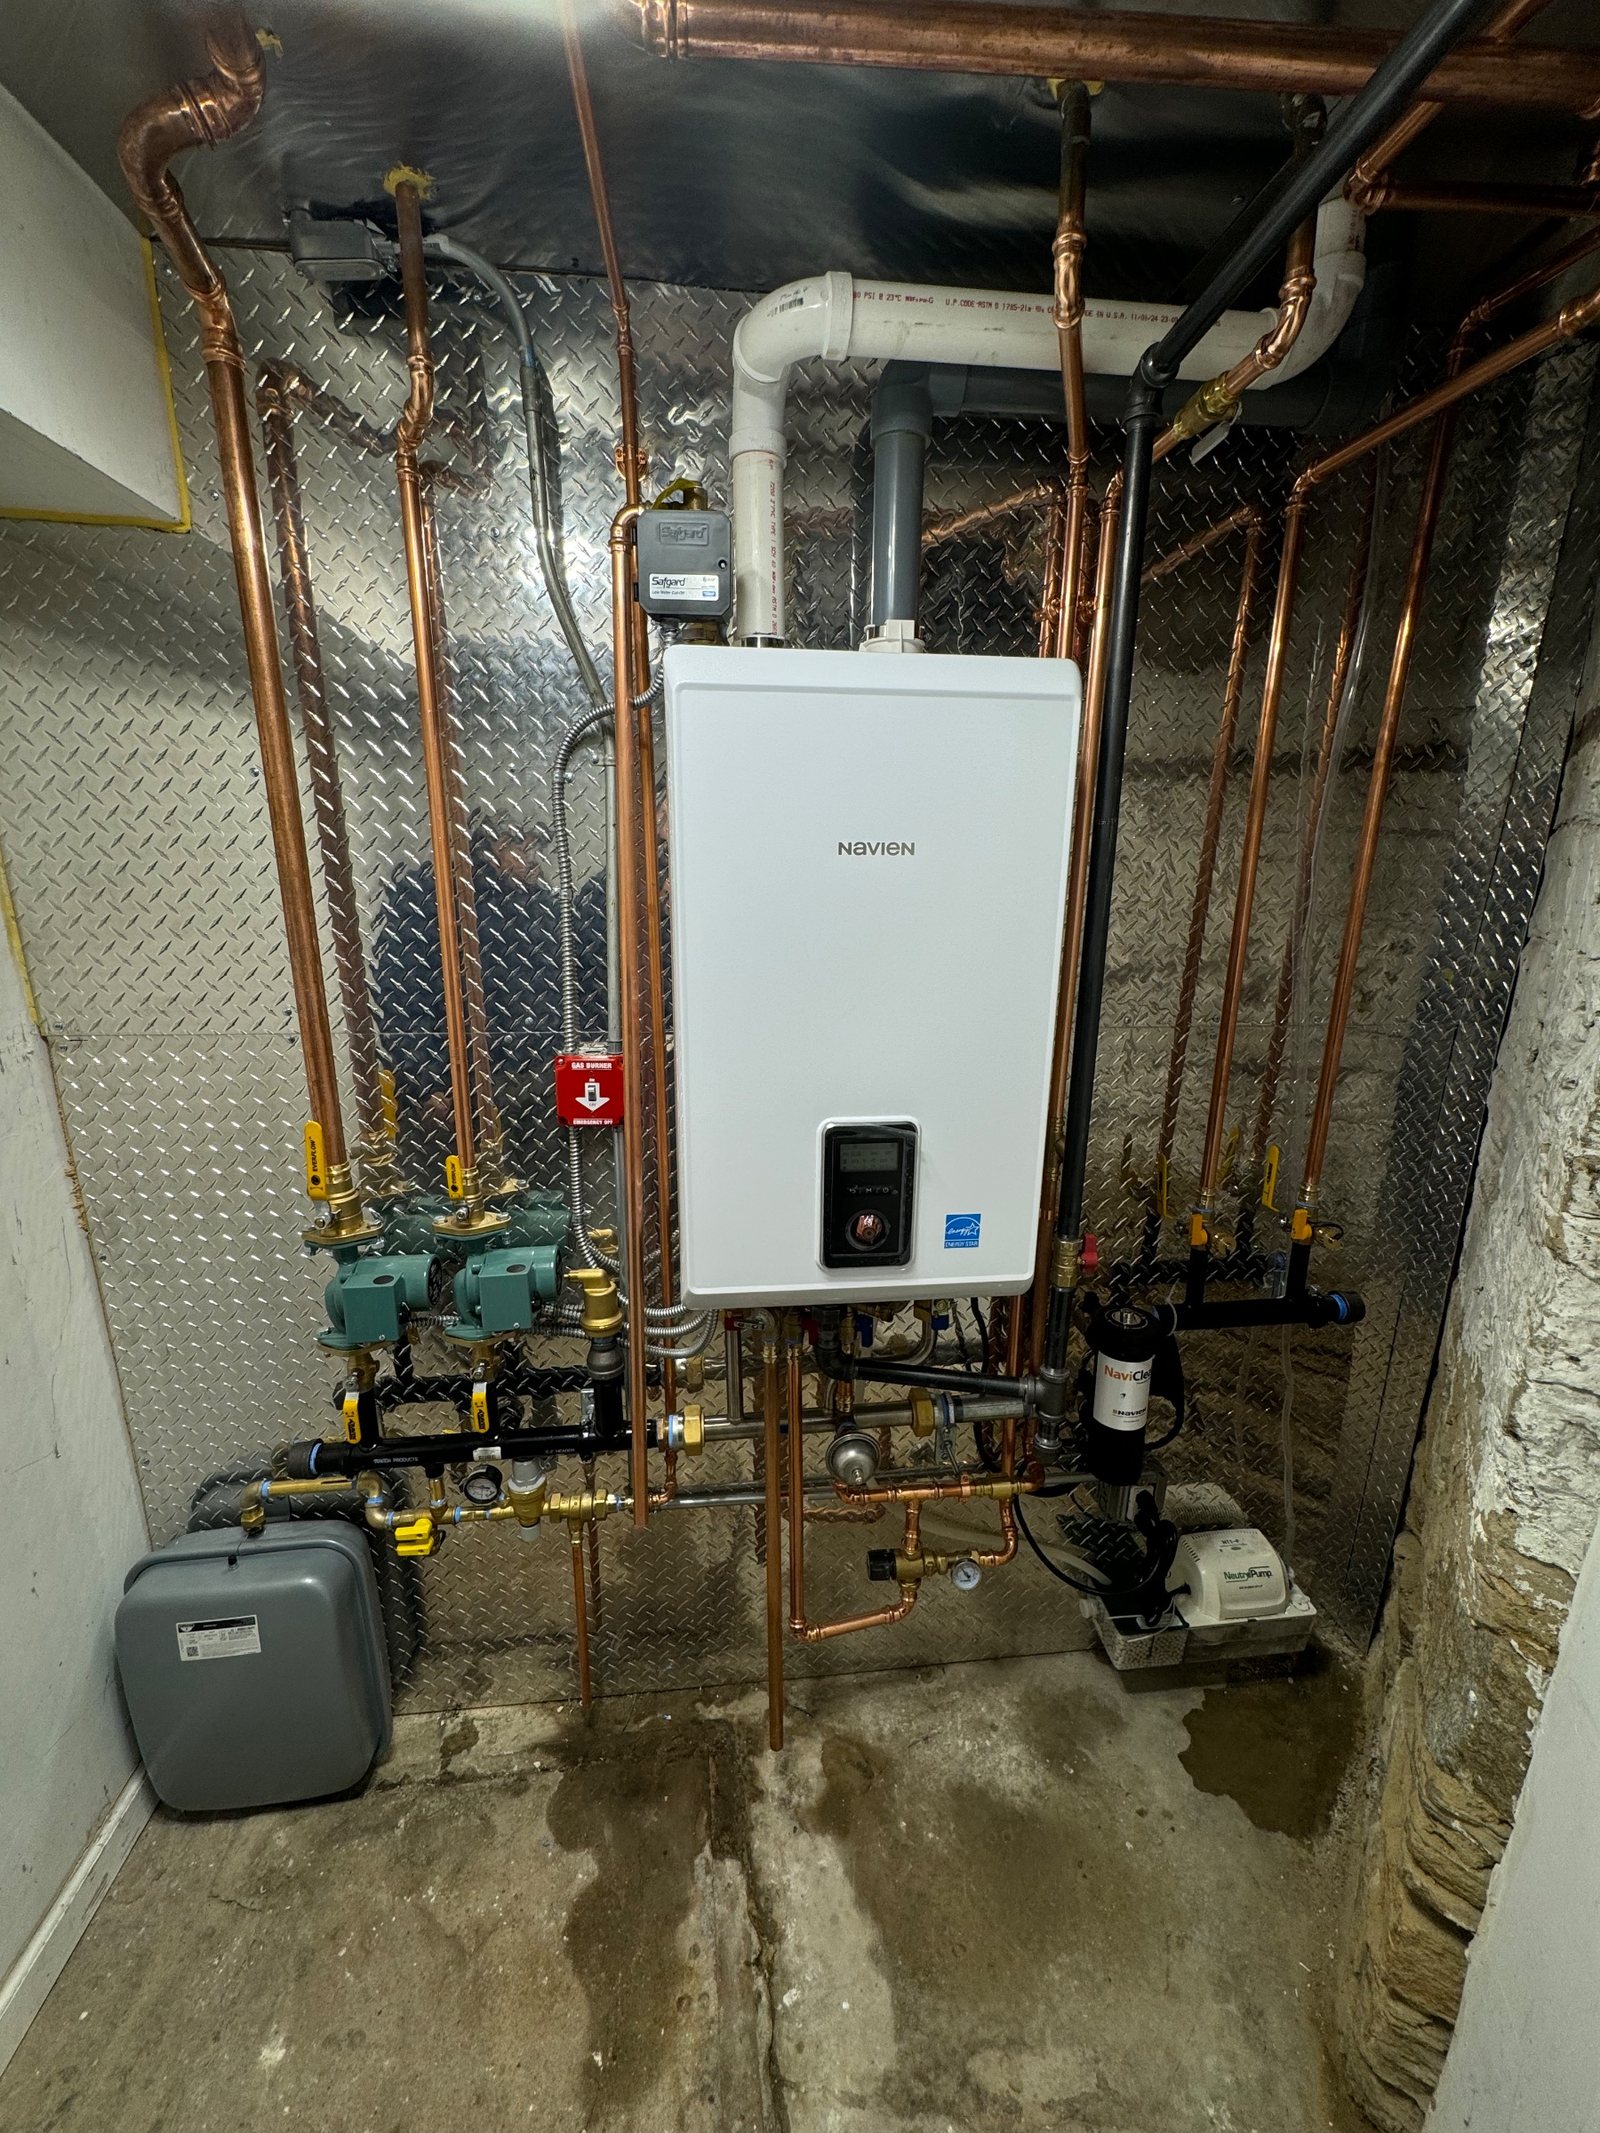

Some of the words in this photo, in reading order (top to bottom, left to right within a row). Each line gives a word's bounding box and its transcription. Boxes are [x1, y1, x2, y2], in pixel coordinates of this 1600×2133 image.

[863, 291, 875, 301] PSI
[661, 526, 707, 542] Safgard
[651, 576, 686, 589] Safgard
[310, 1138, 318, 1172] EVERFLOW
